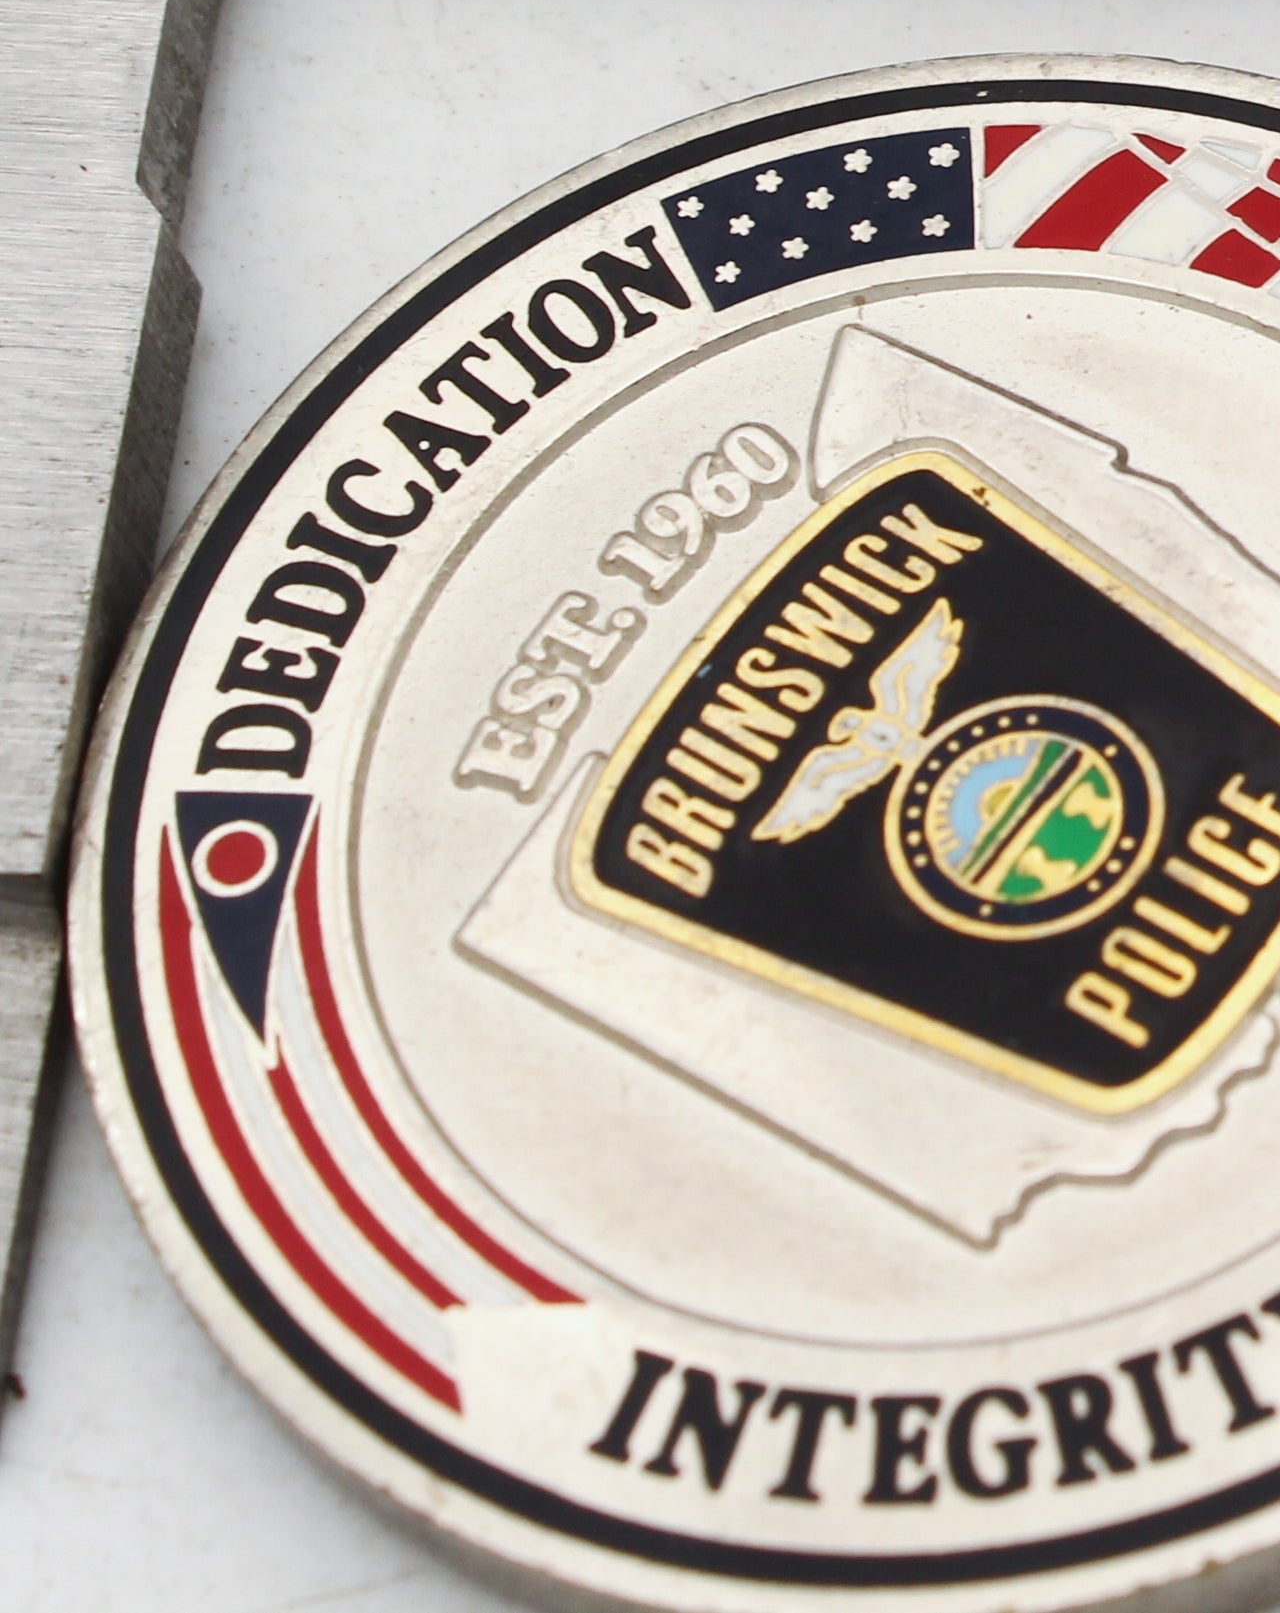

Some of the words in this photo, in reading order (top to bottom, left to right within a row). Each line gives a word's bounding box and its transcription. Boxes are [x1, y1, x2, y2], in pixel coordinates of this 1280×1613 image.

[195, 226, 694, 780] DEDICATION
[452, 592, 648, 805] EST.
[601, 421, 801, 605] 1960
[626, 503, 983, 899] BRUNSWICK
